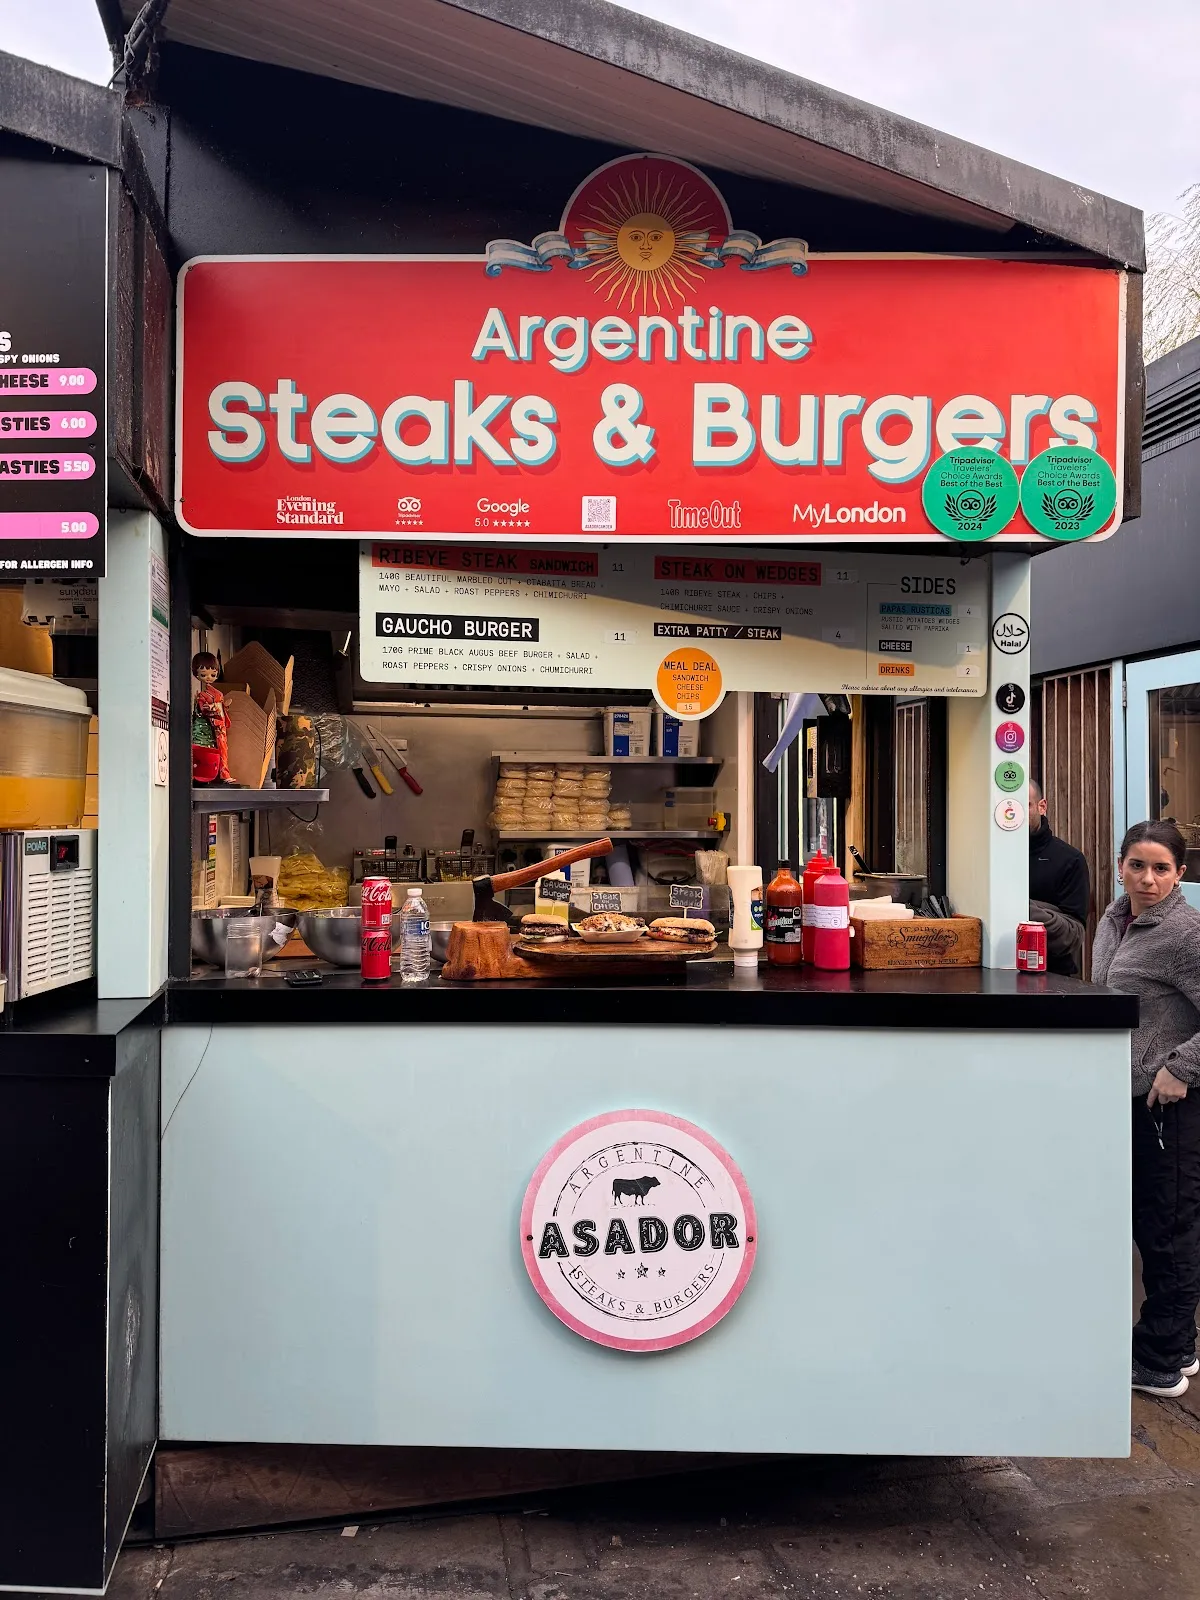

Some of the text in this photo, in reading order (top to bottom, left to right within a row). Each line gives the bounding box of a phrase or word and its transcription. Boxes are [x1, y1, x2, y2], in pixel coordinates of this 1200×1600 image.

[471, 305, 813, 373] Argentine
[22, 354, 60, 364] ONIONS
[0, 374, 84, 388] HEESE 9.00
[0, 416, 86, 431] STIES 6.00
[207, 378, 1098, 484] Steaks & Burgers
[950, 456, 996, 465] Tripadvisor
[1046, 456, 1092, 464] Tripadvisor
[0, 460, 90, 474] ASTIES 5.50
[940, 472, 971, 480] Choice
[1037, 471, 1100, 480] Choice Awards
[276, 498, 336, 514] Evening
[476, 498, 530, 516] Google
[276, 511, 344, 524] Standard
[792, 501, 906, 528] MyLondon
[60, 522, 88, 533] 5.00
[474, 518, 490, 527] 5.0
[958, 522, 982, 530] 2024
[1054, 522, 1080, 530] 2023
[20, 560, 69, 569] ALLERGEN
[71, 560, 94, 569] INFO
[380, 548, 594, 572] RIBEYE STEAK SANDWICH
[612, 563, 624, 572] 11
[661, 561, 818, 582] STEAK ON WEDGES
[378, 572, 400, 580] 140G
[405, 574, 452, 582] BEAUTIFUL
[456, 576, 492, 584] MARBLED
[572, 580, 596, 588] BREAD
[836, 572, 850, 580] 11
[60, 586, 97, 597] napkins
[900, 576, 956, 595] SIDES
[454, 588, 479, 596] ROAST
[484, 588, 520, 597] PEPPERS
[534, 590, 588, 600] CHIMICHURRI
[660, 602, 713, 612] CHIMICHURRI
[786, 607, 814, 616] ONIONS
[882, 604, 950, 615] PAPAS RUSTICAS
[382, 618, 532, 638] GAUCHO BURGER
[658, 625, 780, 638] EXTRA PATTY / STEAK
[836, 630, 841, 638] 4
[996, 623, 1026, 638] حلال
[614, 632, 626, 641] 11
[880, 642, 911, 650] CHEESE
[408, 647, 434, 655] PRIME
[498, 650, 518, 658] BEEF
[524, 650, 553, 658] BURGER
[414, 662, 449, 670] PEPPERS
[462, 664, 492, 672] CRISPY
[497, 664, 527, 672] ONIONS
[540, 666, 593, 674] CHUMICHURRI
[664, 662, 716, 672] MEAL DEAL
[880, 666, 910, 674] DRINKS
[542, 888, 570, 900] Burger
[900, 926, 952, 948] Smuggler
[568, 1147, 706, 1195] ARGENTINE
[538, 1212, 740, 1258] ASADOR
[574, 1264, 714, 1314] STEAKS & BURGERS
